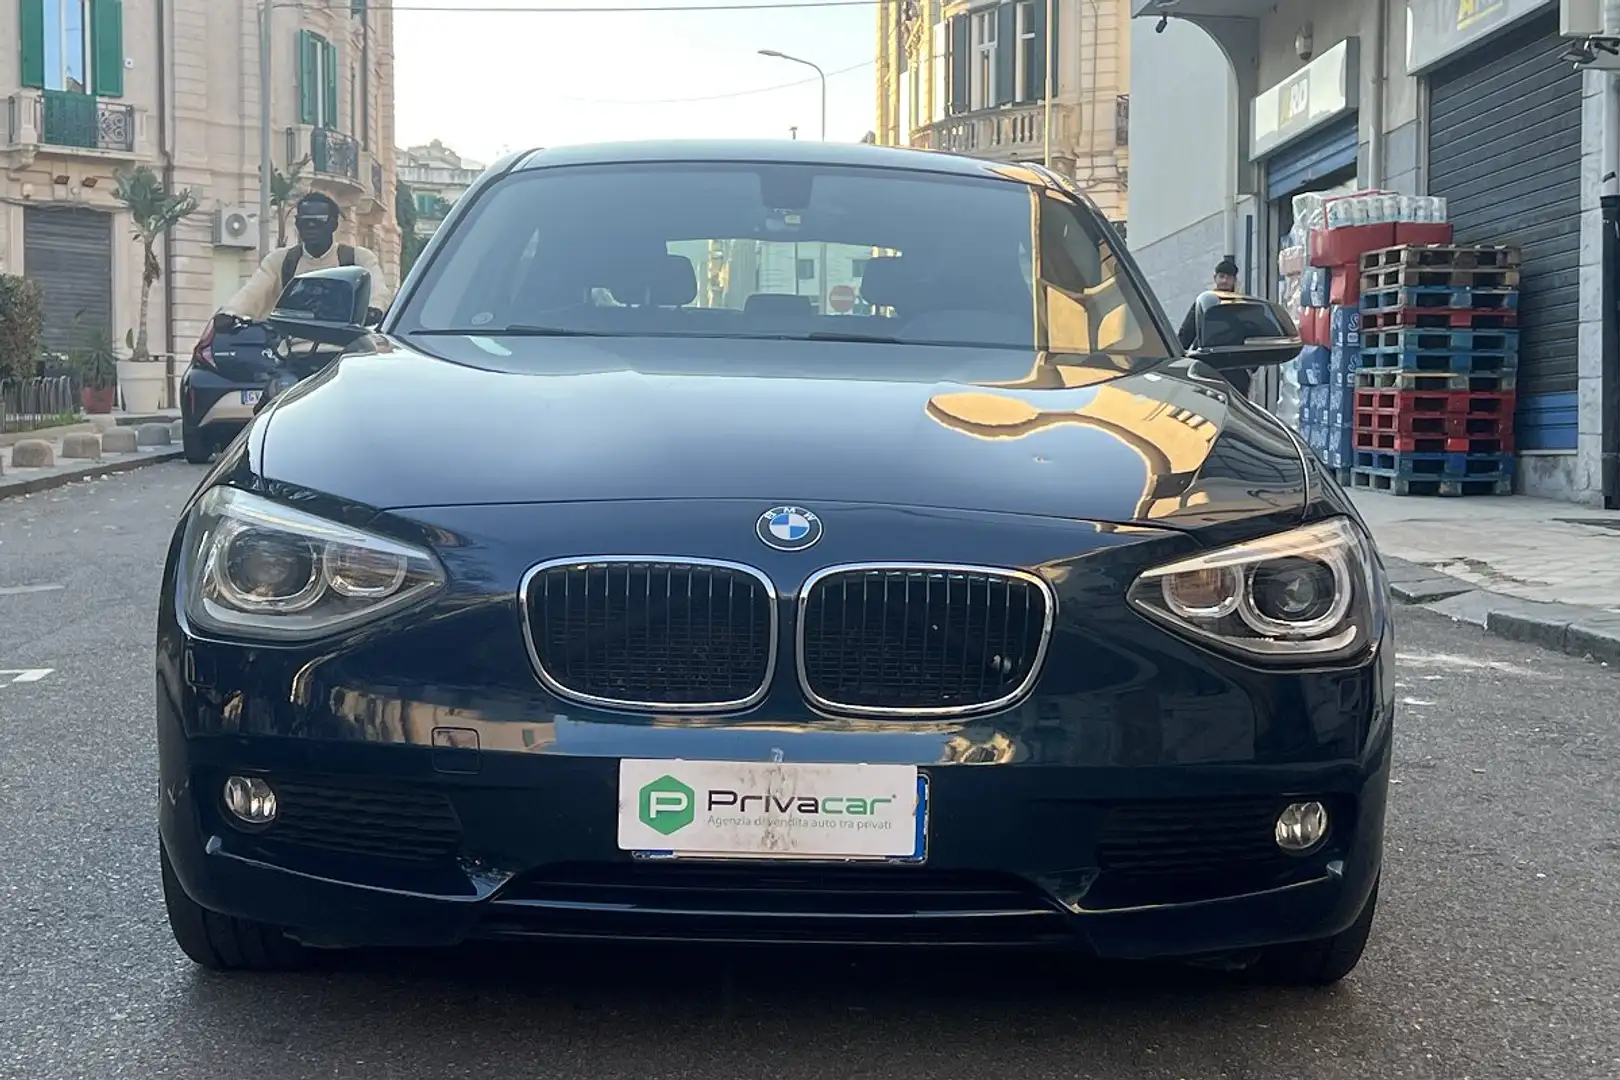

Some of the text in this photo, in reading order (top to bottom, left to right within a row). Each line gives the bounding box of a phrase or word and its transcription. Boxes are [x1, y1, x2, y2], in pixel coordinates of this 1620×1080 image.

[763, 506, 816, 520] BMW
[650, 791, 688, 818] P
[707, 789, 892, 816] Privacar
[707, 815, 752, 828] Agenzia
[811, 819, 837, 829] auto
[839, 819, 855, 829] tra
[857, 820, 892, 831] privati
